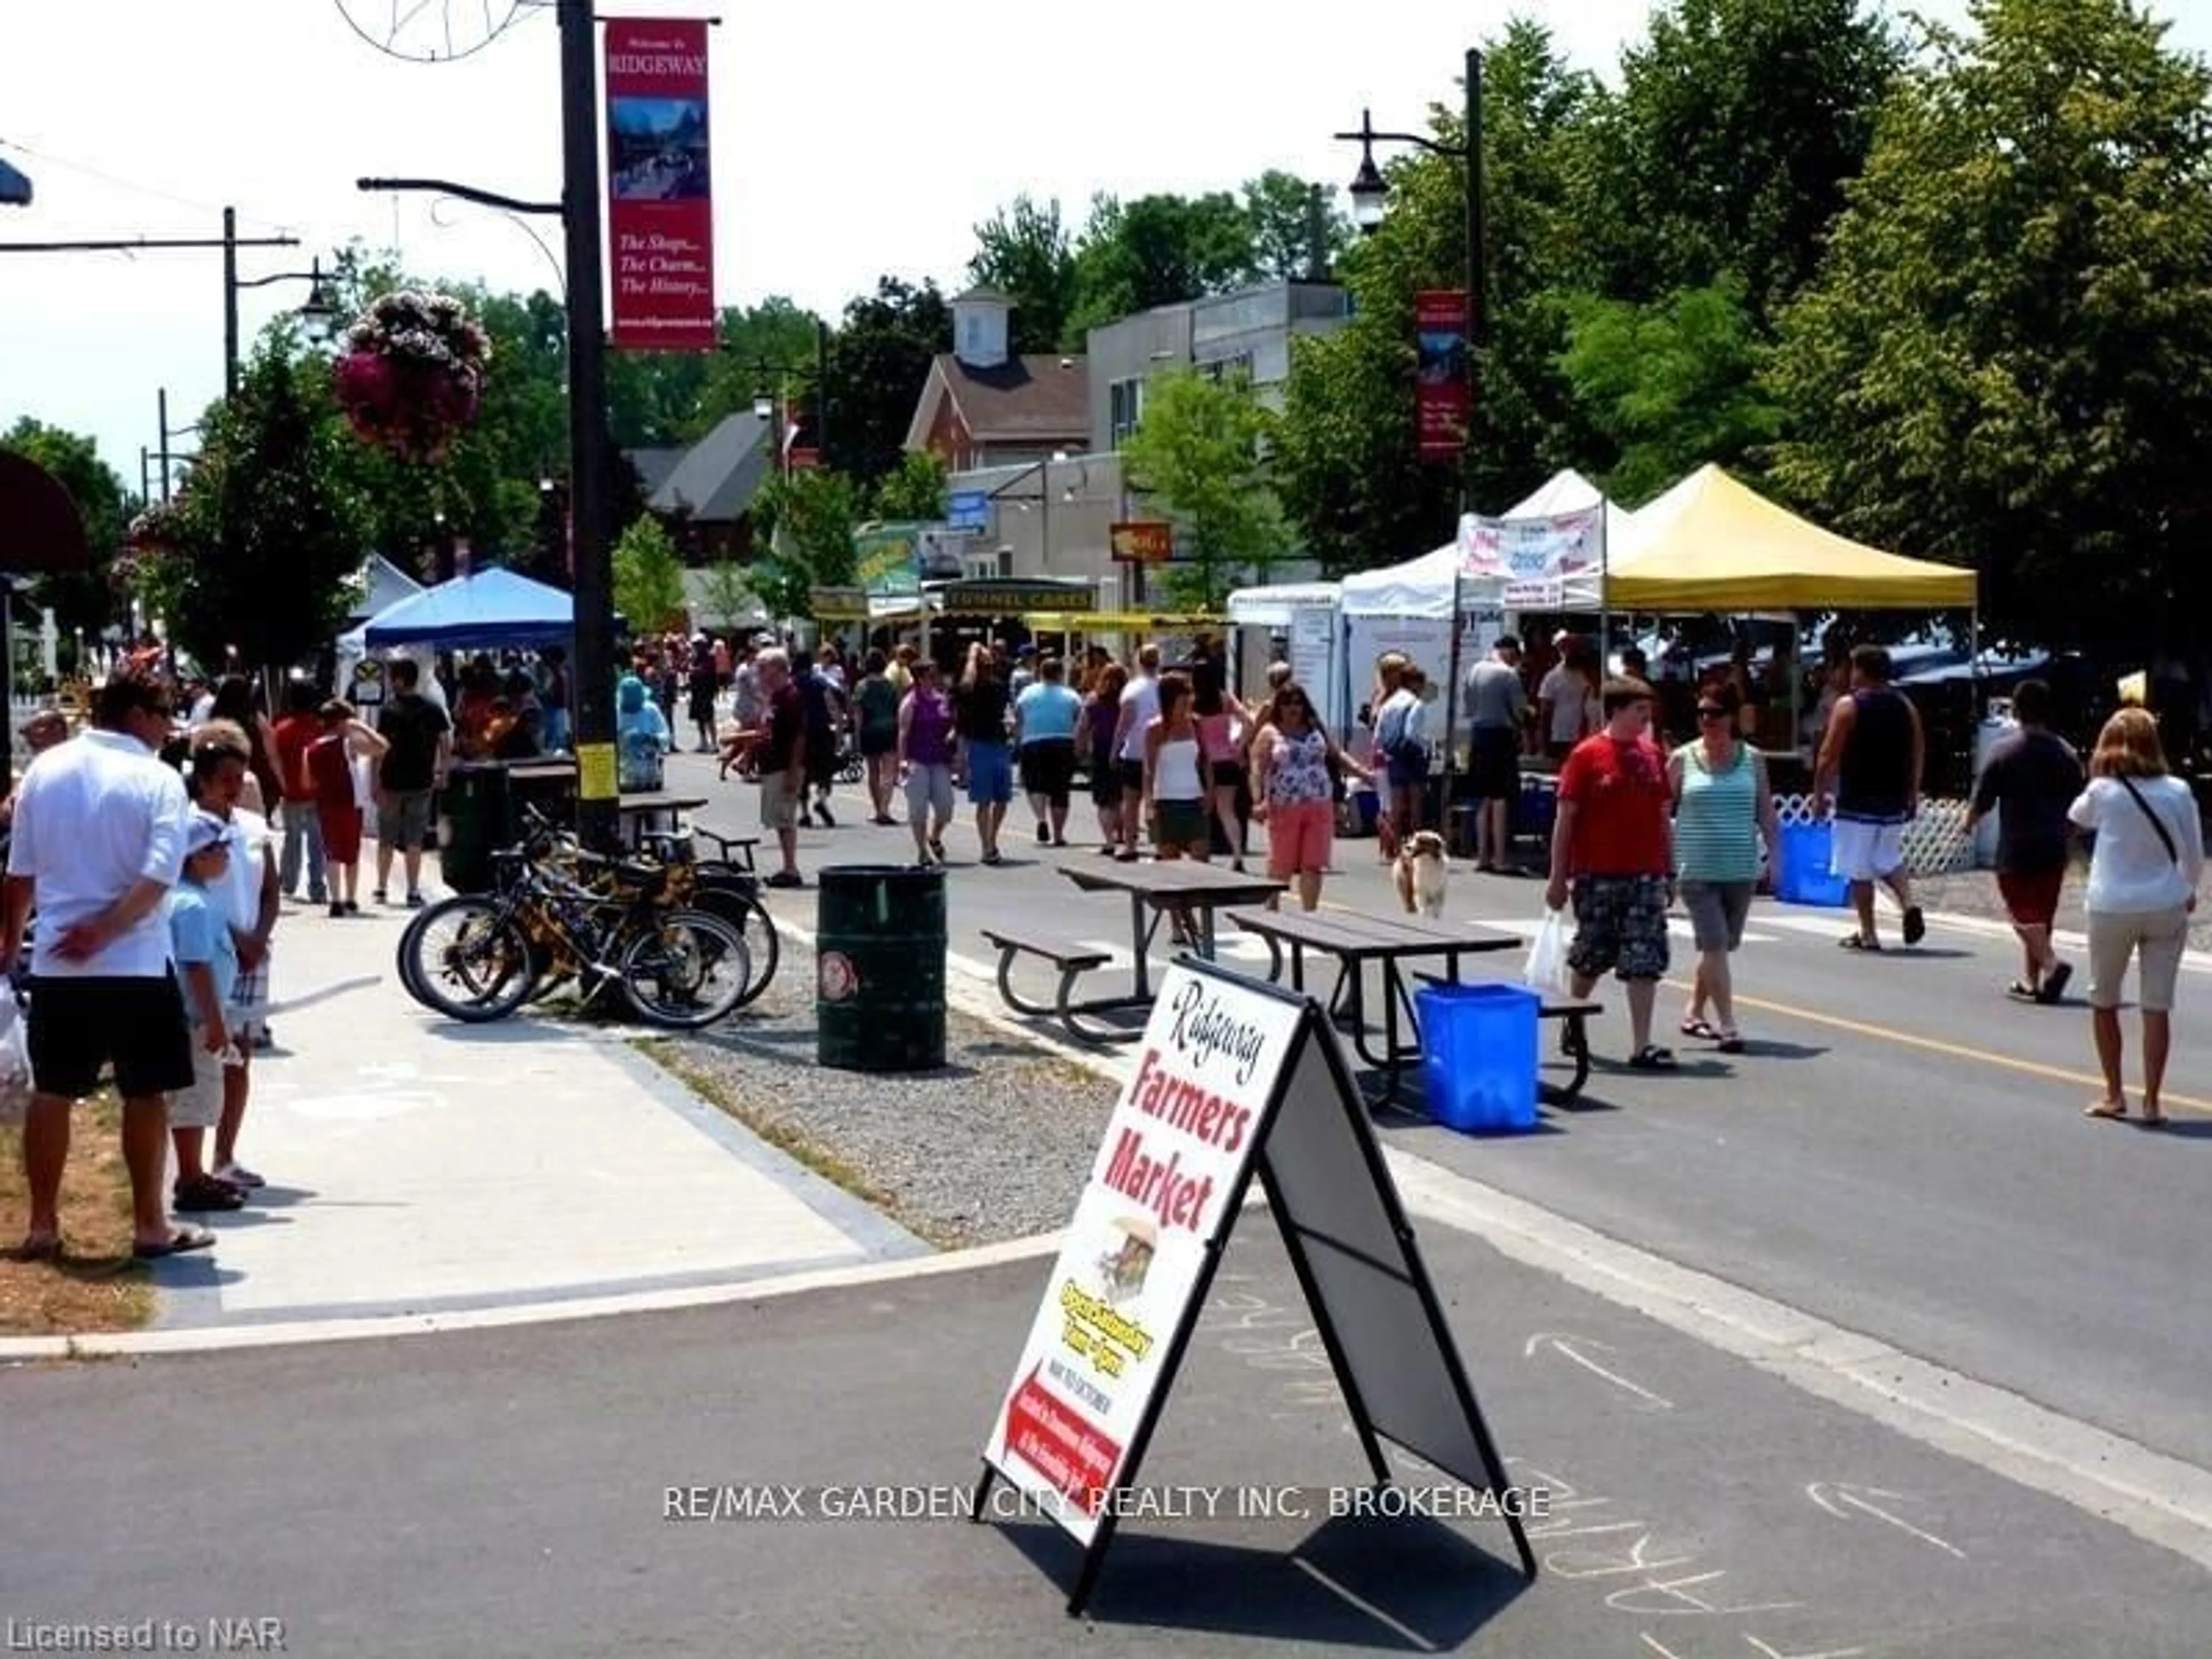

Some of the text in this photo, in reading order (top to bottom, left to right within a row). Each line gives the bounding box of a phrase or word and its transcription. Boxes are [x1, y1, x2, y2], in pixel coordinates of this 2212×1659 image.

[608, 55, 707, 75] RIDGEWAY
[620, 234, 645, 251] The
[620, 256, 646, 272] The
[621, 278, 646, 294] The
[1169, 980, 1266, 1086] Ridgeway
[1128, 1048, 1251, 1153] Farmers
[1104, 1127, 1214, 1232] Market
